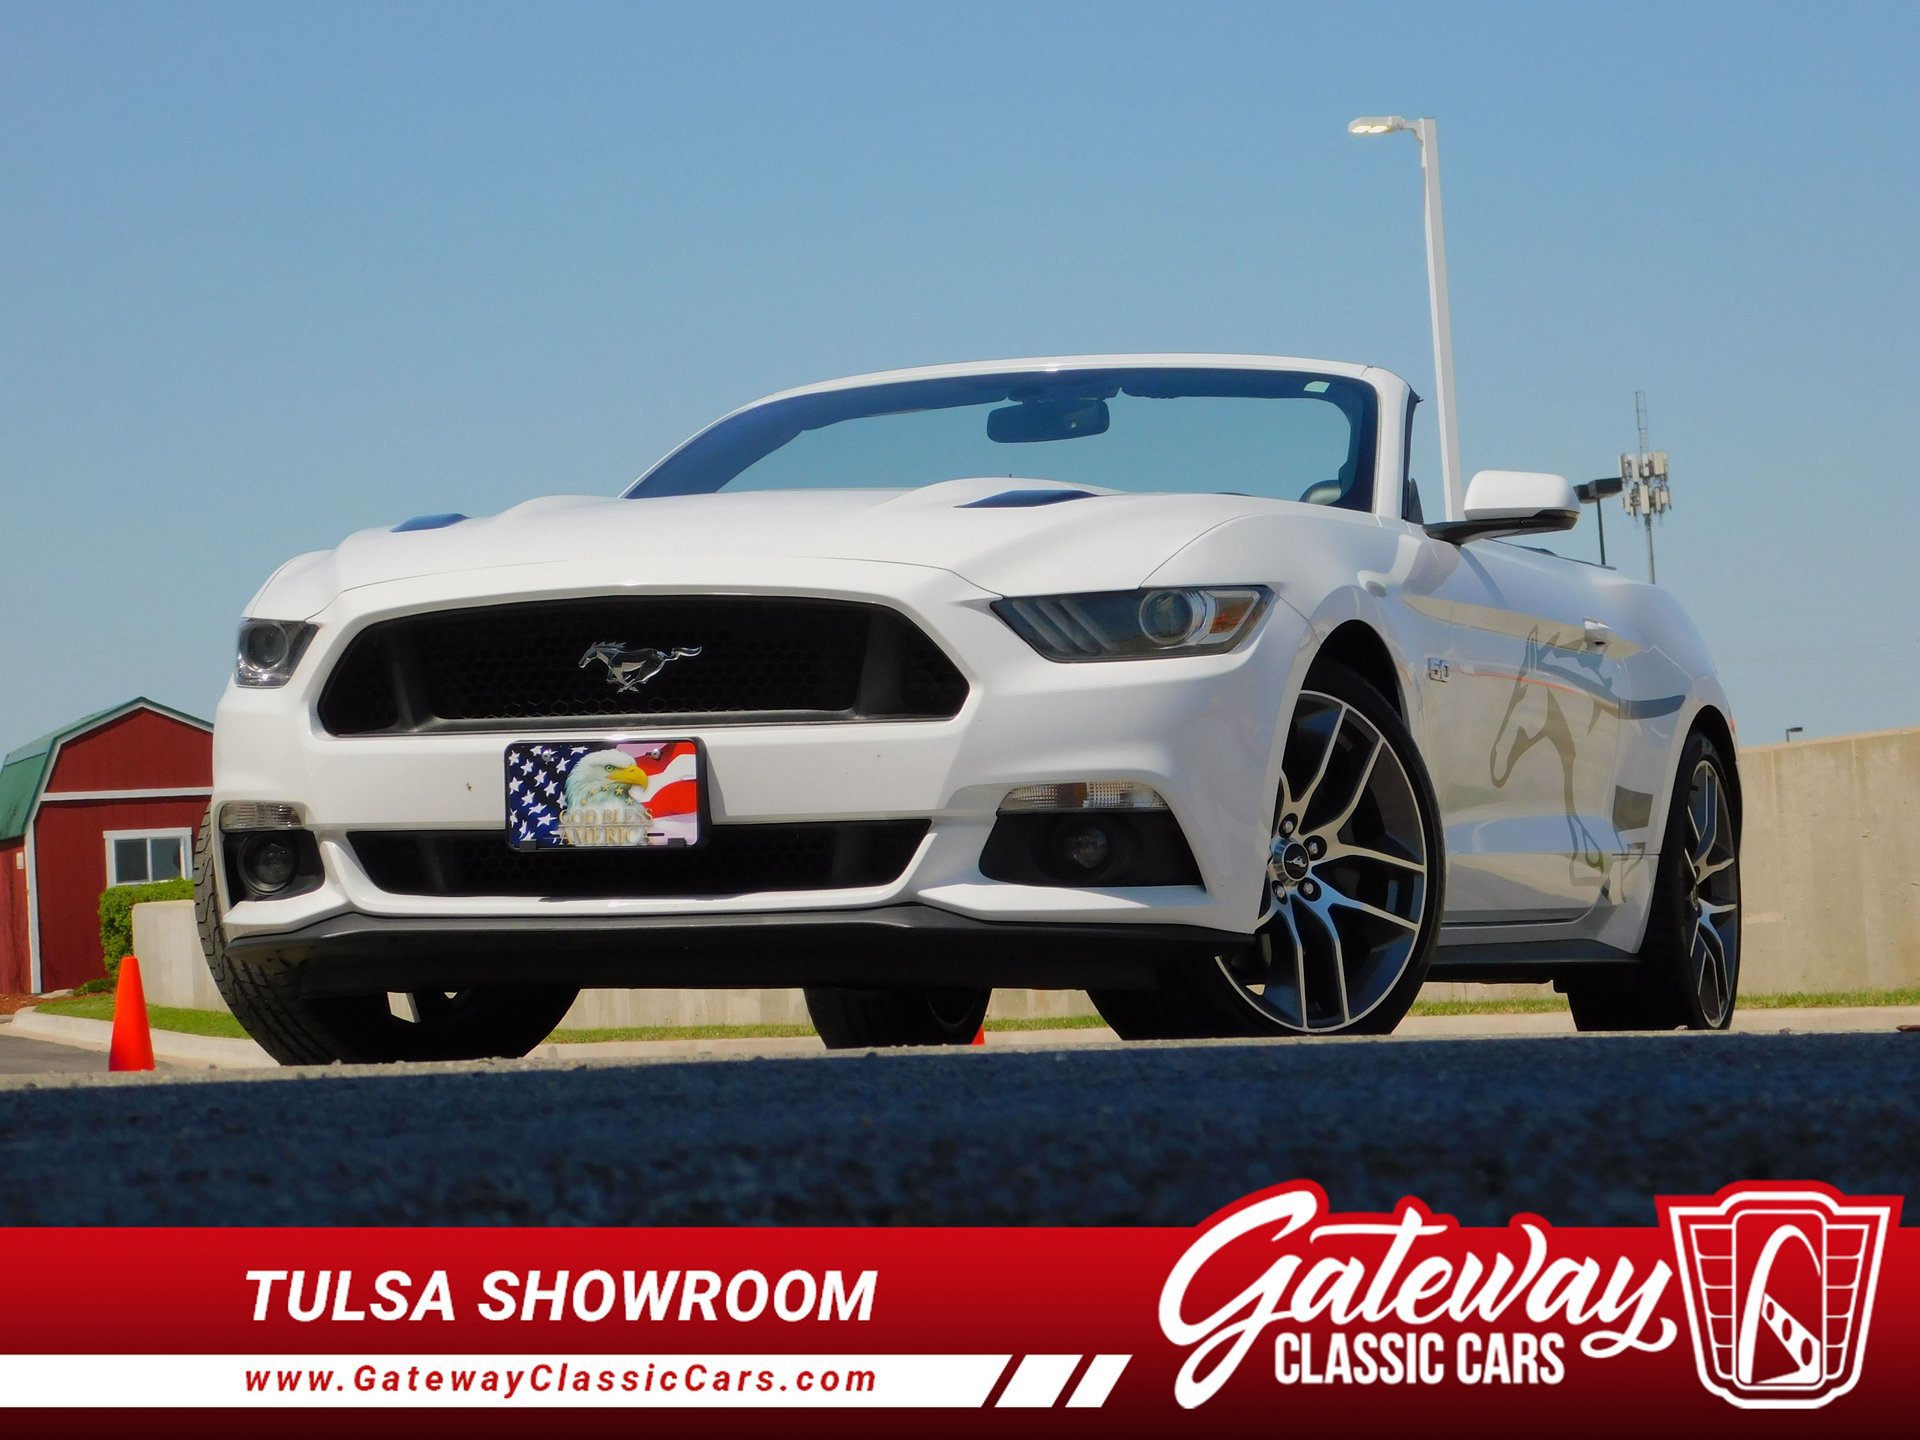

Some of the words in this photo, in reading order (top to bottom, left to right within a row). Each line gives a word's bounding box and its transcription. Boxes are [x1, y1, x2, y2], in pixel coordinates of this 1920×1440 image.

[559, 809, 597, 825] GOD
[603, 809, 654, 825] BLESS
[559, 825, 653, 845] AMERICA
